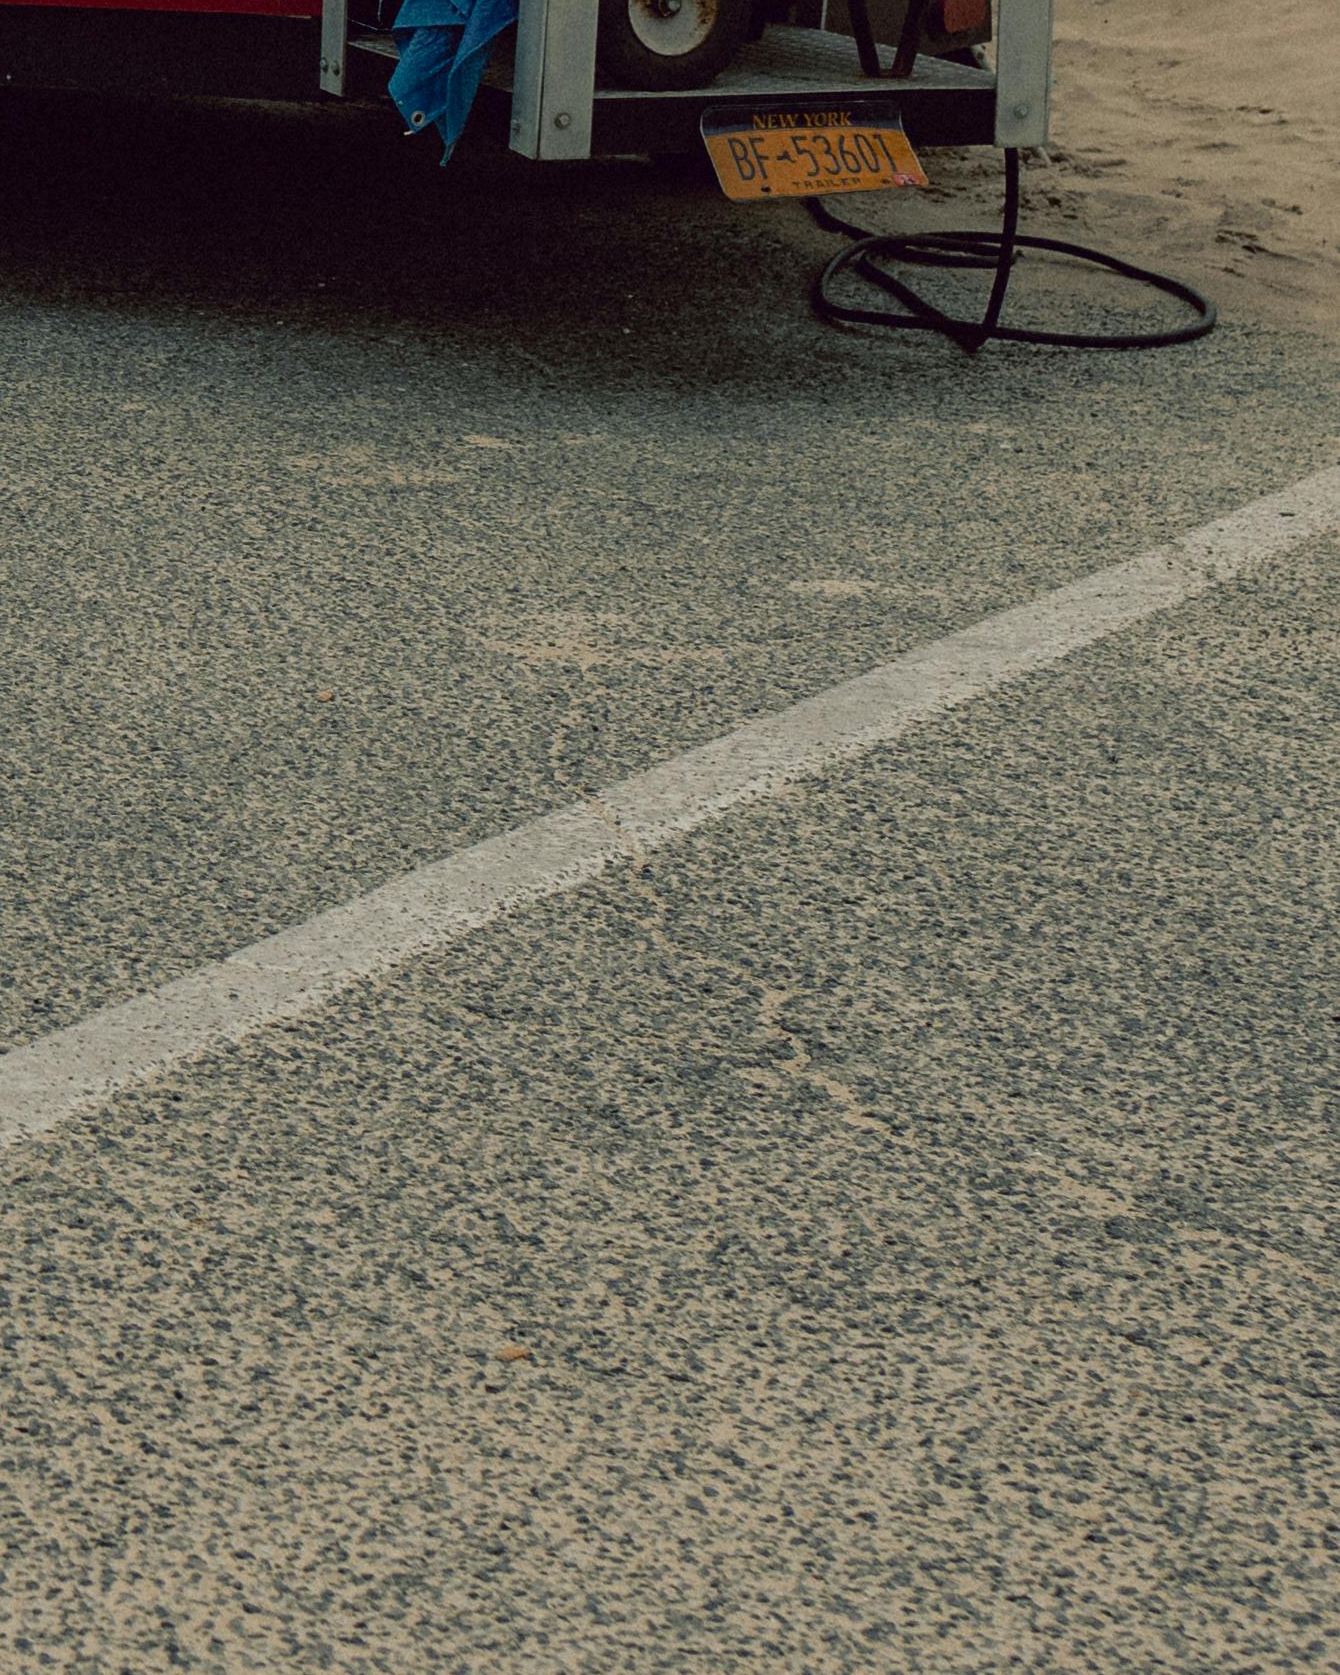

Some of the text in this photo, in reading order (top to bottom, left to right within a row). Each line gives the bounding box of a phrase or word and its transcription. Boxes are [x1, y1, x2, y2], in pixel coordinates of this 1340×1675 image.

[752, 110, 853, 130] NEW YORK
[728, 133, 898, 181] BF 53601
[792, 177, 862, 189] TRAILER
